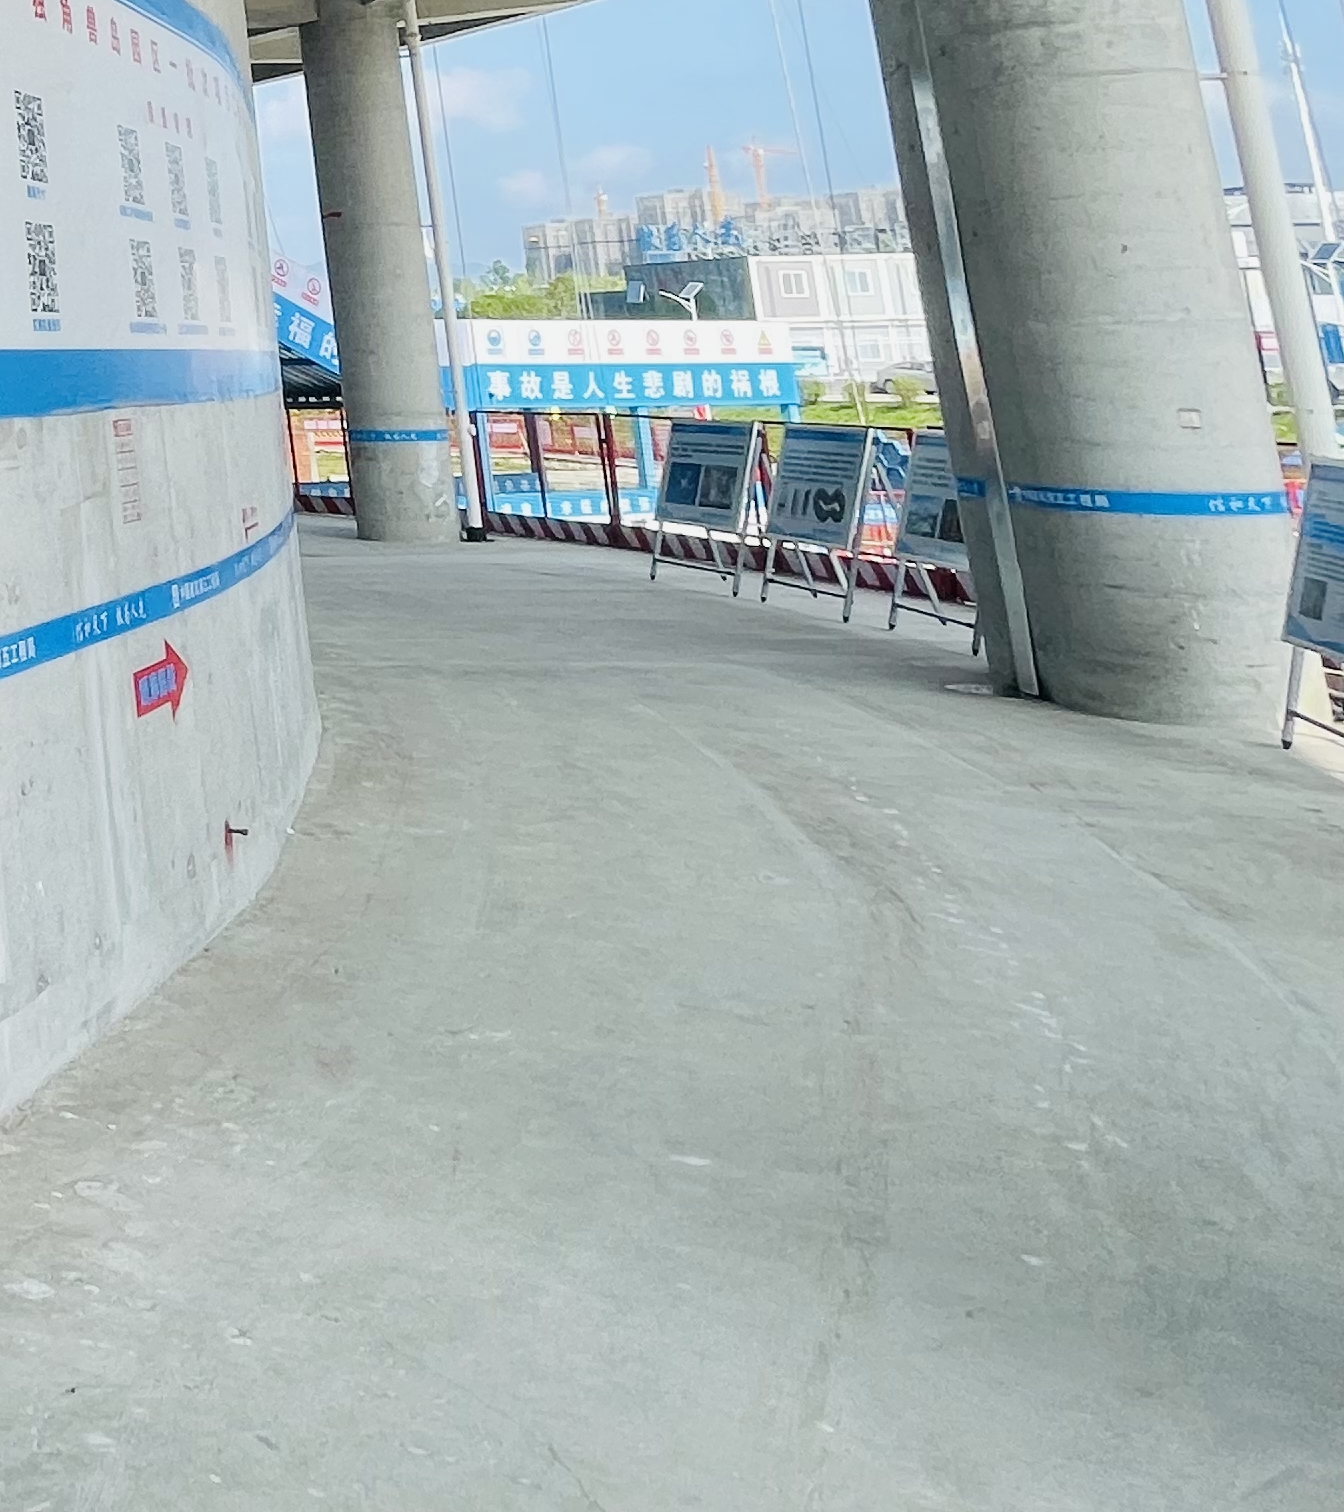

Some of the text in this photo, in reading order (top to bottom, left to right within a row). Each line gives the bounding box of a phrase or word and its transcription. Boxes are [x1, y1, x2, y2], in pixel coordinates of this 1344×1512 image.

[486, 370, 782, 401] 事故是人生悲剧的祸根
